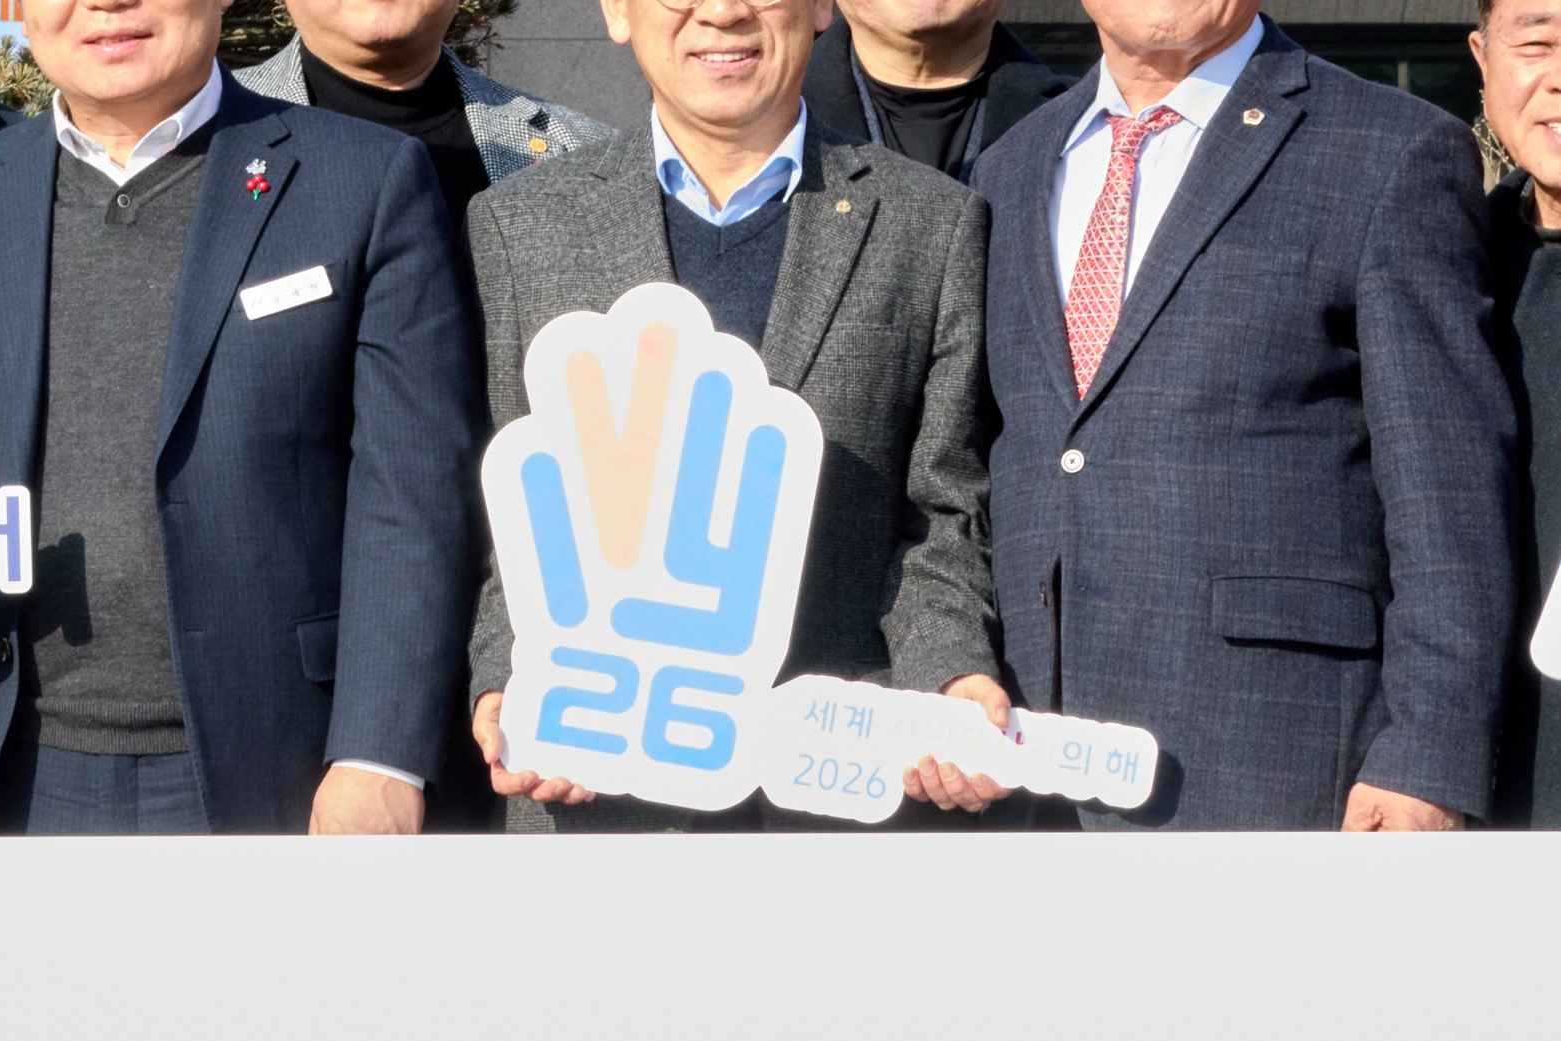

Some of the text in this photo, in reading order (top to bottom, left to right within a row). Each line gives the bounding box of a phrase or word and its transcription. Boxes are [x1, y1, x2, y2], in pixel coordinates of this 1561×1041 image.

[534, 646, 746, 774] 26
[803, 699, 873, 739] 세계
[792, 753, 888, 801] 2026
